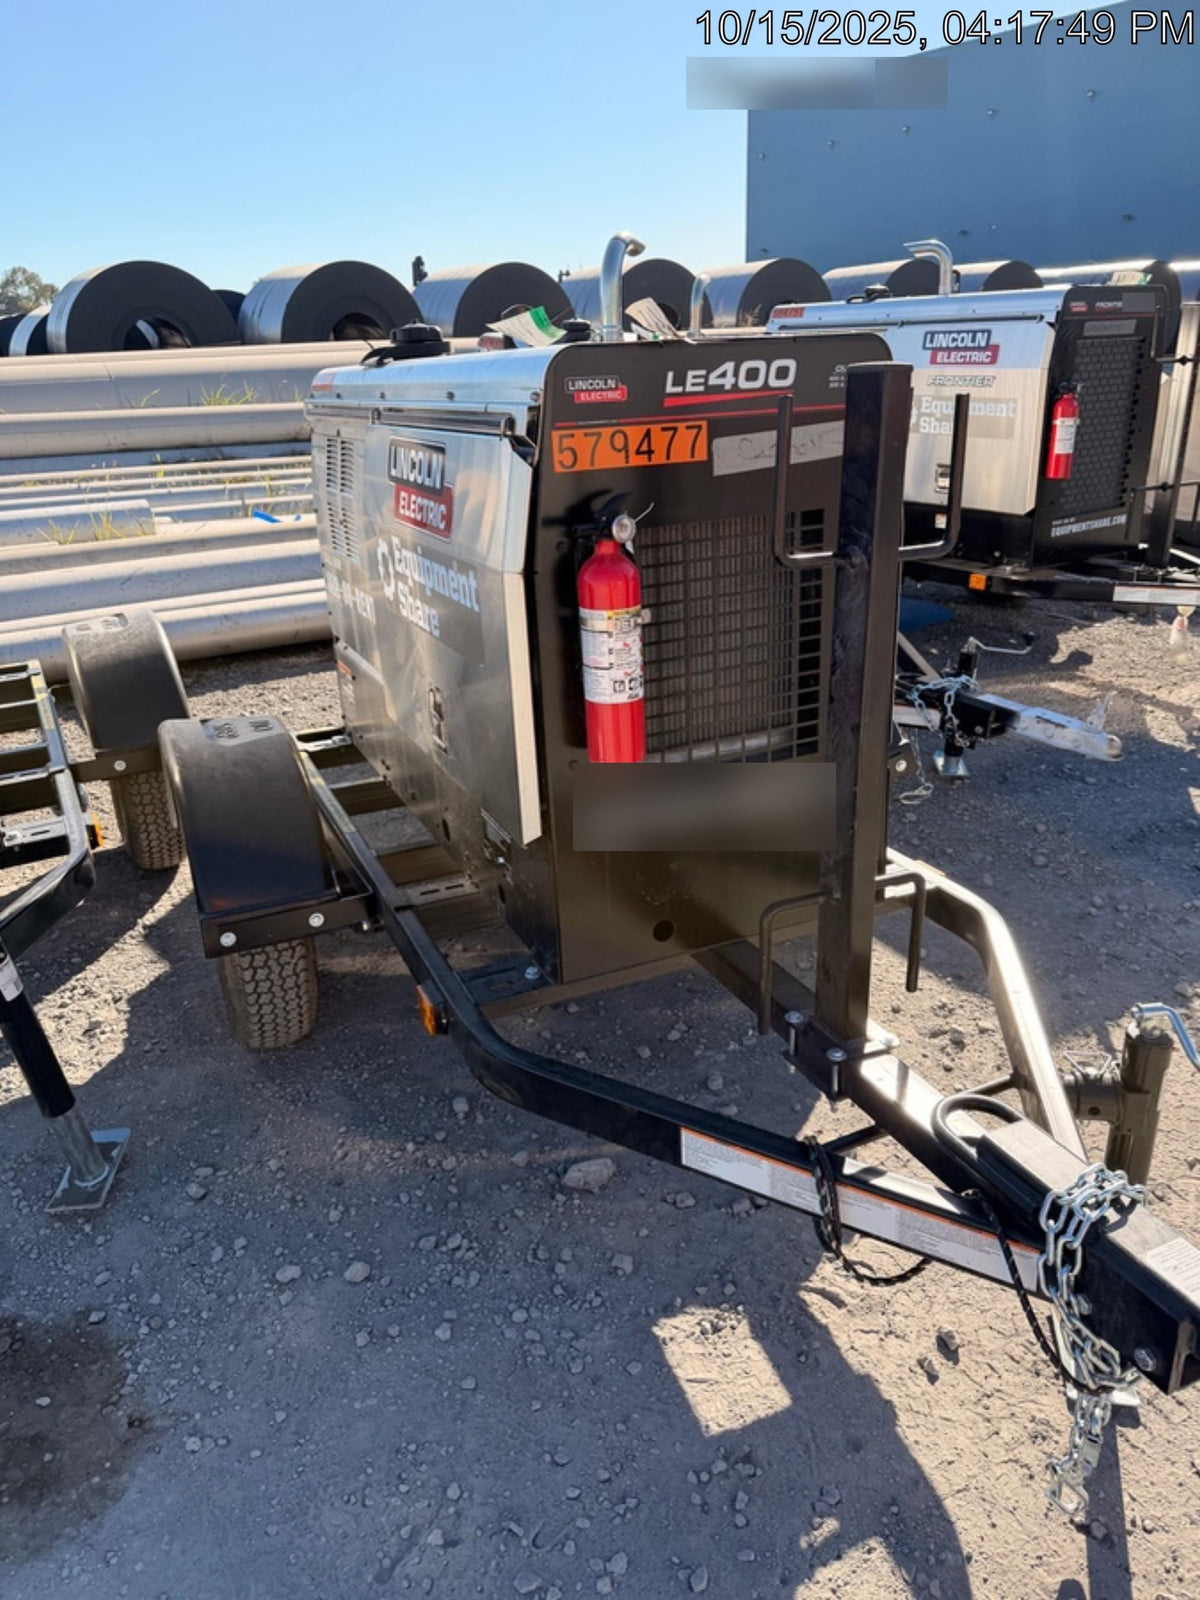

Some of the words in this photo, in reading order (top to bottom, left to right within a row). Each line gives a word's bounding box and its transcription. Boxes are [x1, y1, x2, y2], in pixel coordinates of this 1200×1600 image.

[925, 332, 988, 348] LINCOLN
[936, 351, 992, 364] ELECTRIC
[568, 378, 616, 391] LINCOLN
[665, 358, 797, 394] LE400
[927, 374, 996, 388] FRONTIER
[579, 389, 623, 401] ELECTRIC
[921, 396, 1016, 418] Equment
[919, 415, 954, 434] Sha
[558, 424, 704, 471] 579477
[390, 446, 443, 489] LINCOLN
[399, 491, 446, 530] ELECTRIC
[391, 535, 479, 612] Equipment
[397, 581, 440, 638] Share
